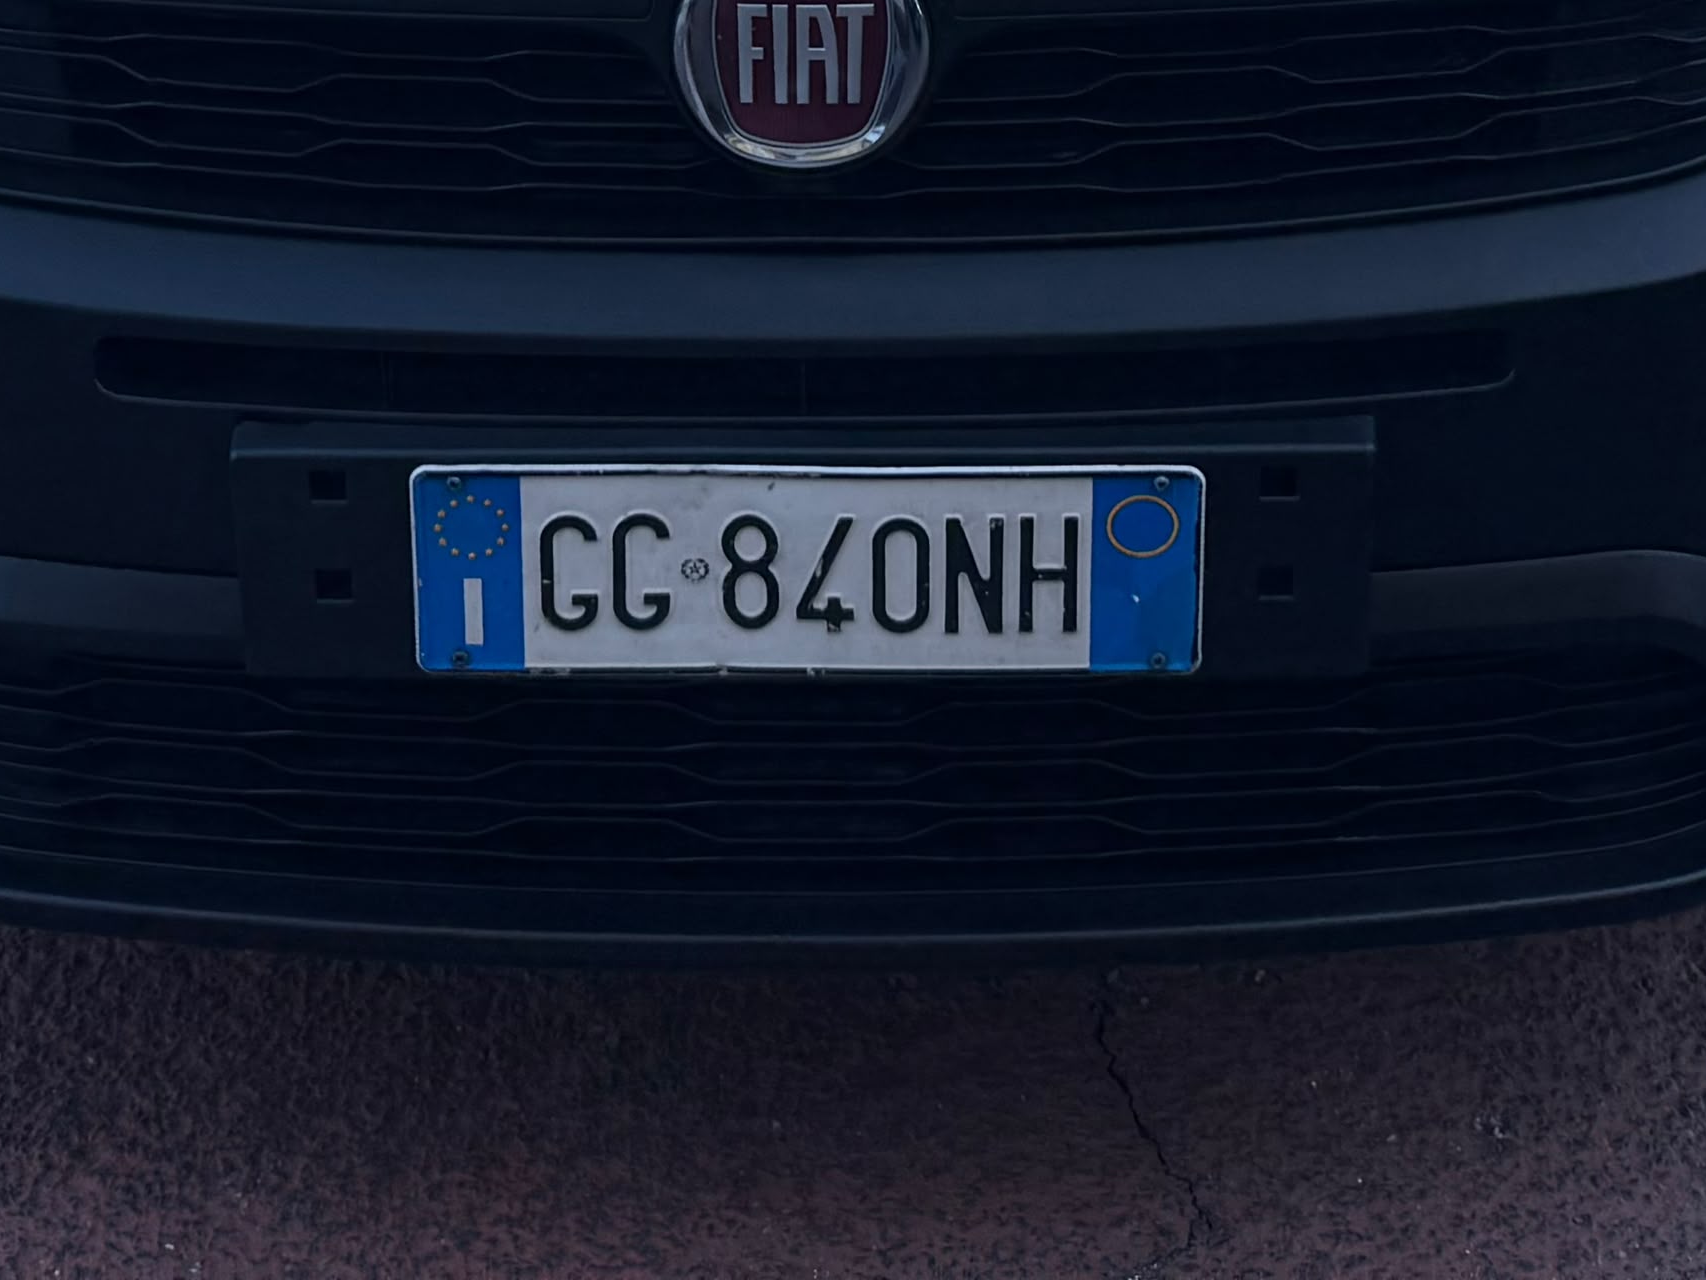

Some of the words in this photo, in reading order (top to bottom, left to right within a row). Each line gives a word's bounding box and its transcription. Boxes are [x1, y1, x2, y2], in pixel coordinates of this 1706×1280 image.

[736, 2, 875, 105] FIAT
[539, 512, 672, 632] GG
[720, 512, 1080, 635] 840NH
